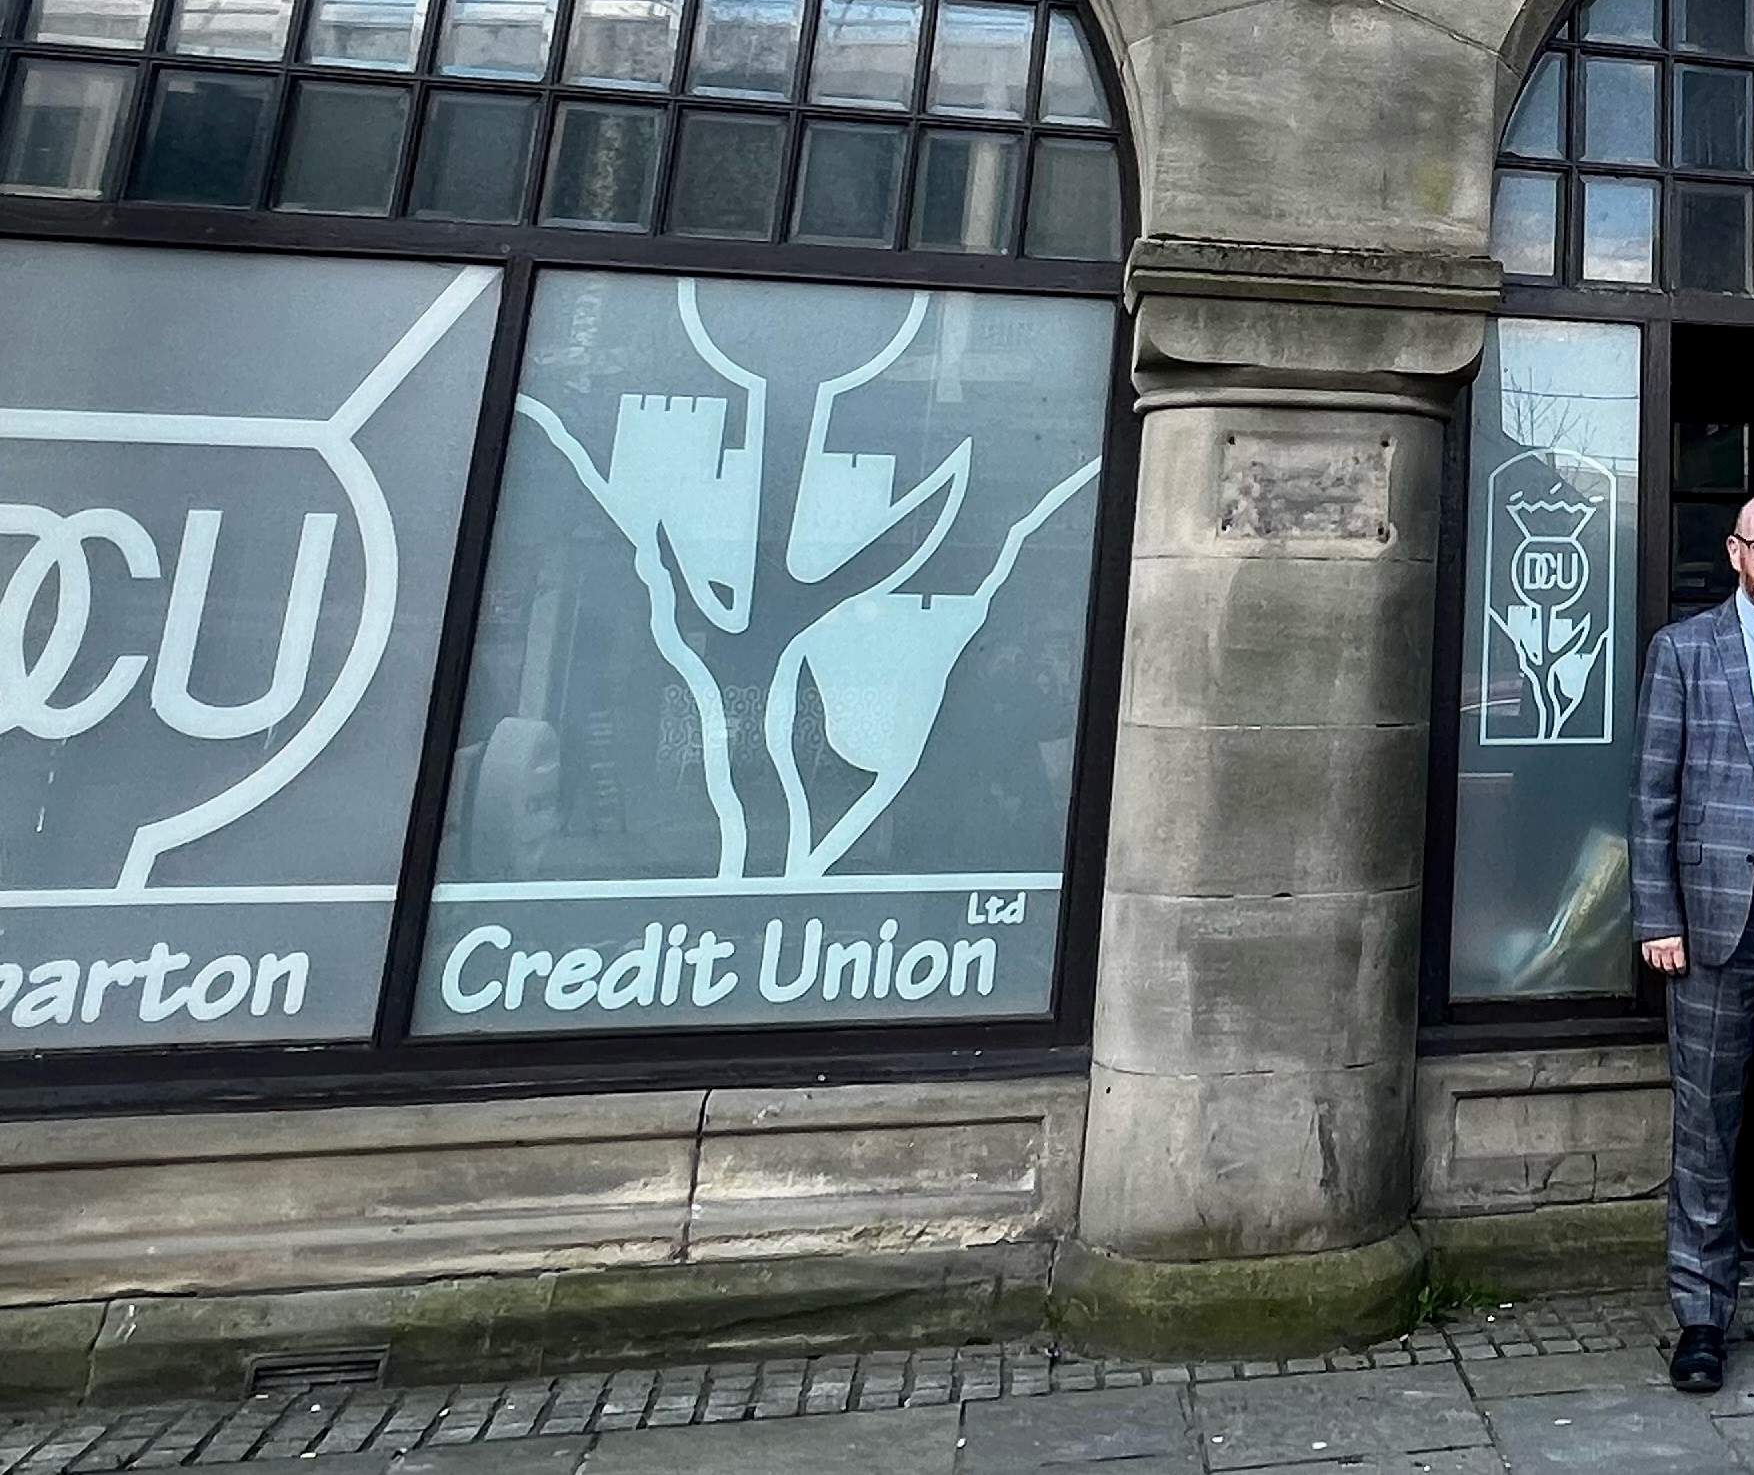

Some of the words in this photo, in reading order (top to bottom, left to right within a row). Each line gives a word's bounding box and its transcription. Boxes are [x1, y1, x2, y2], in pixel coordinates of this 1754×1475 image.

[1523, 552, 1579, 591] DCU
[967, 892, 1026, 926] Ltd
[441, 922, 738, 1014] Credit
[758, 917, 997, 1003] Union
